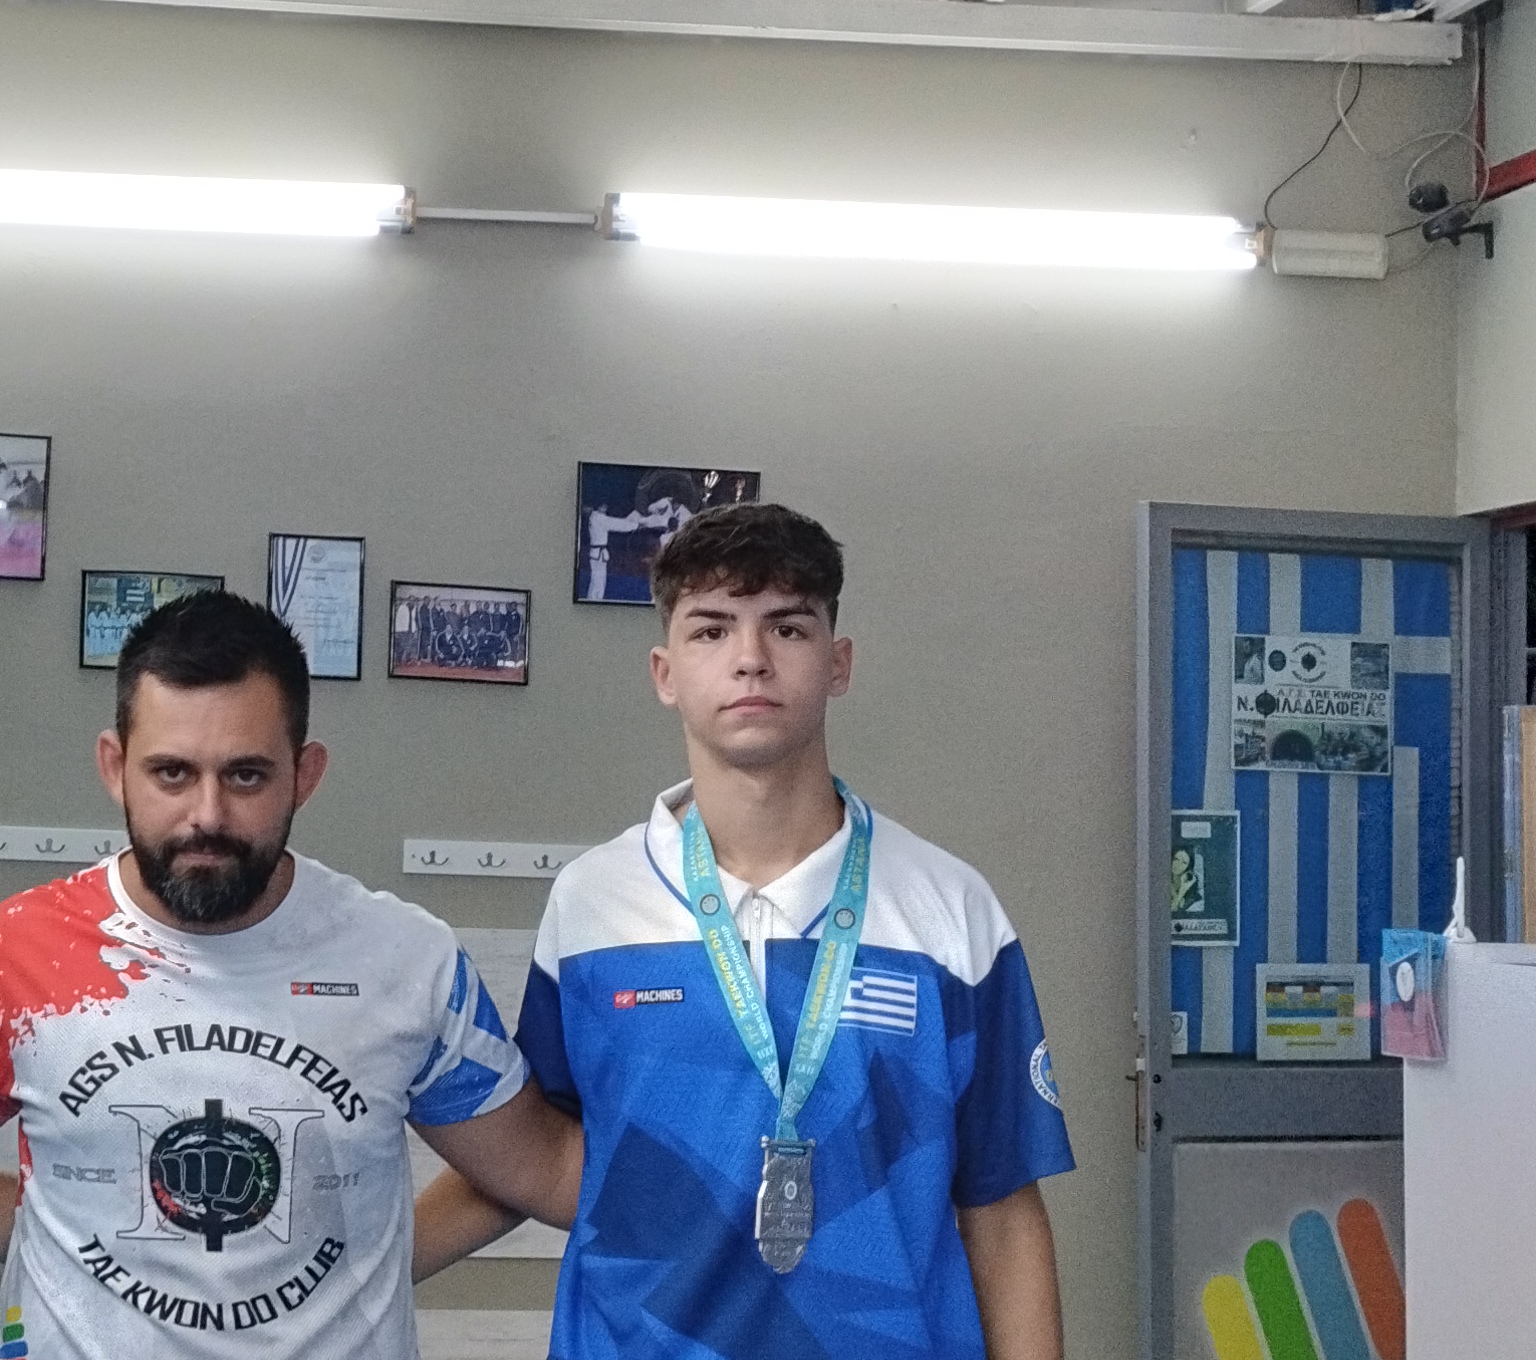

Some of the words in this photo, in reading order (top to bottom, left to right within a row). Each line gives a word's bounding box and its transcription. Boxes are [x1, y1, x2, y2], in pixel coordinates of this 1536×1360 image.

[720, 925, 754, 998] CHAMPIONSHIP
[636, 989, 683, 1003] MACHINES
[751, 1002, 768, 1040] WORLD
[58, 1050, 120, 1117] AGS
[111, 1034, 155, 1067] N.
[153, 1023, 368, 1123] FILADELFEIAS
[52, 1162, 117, 1184] SINCE
[78, 1233, 131, 1285] TAE
[121, 1280, 225, 1331] KWON
[231, 1293, 279, 1331] DO
[275, 1237, 345, 1312] CLUB
